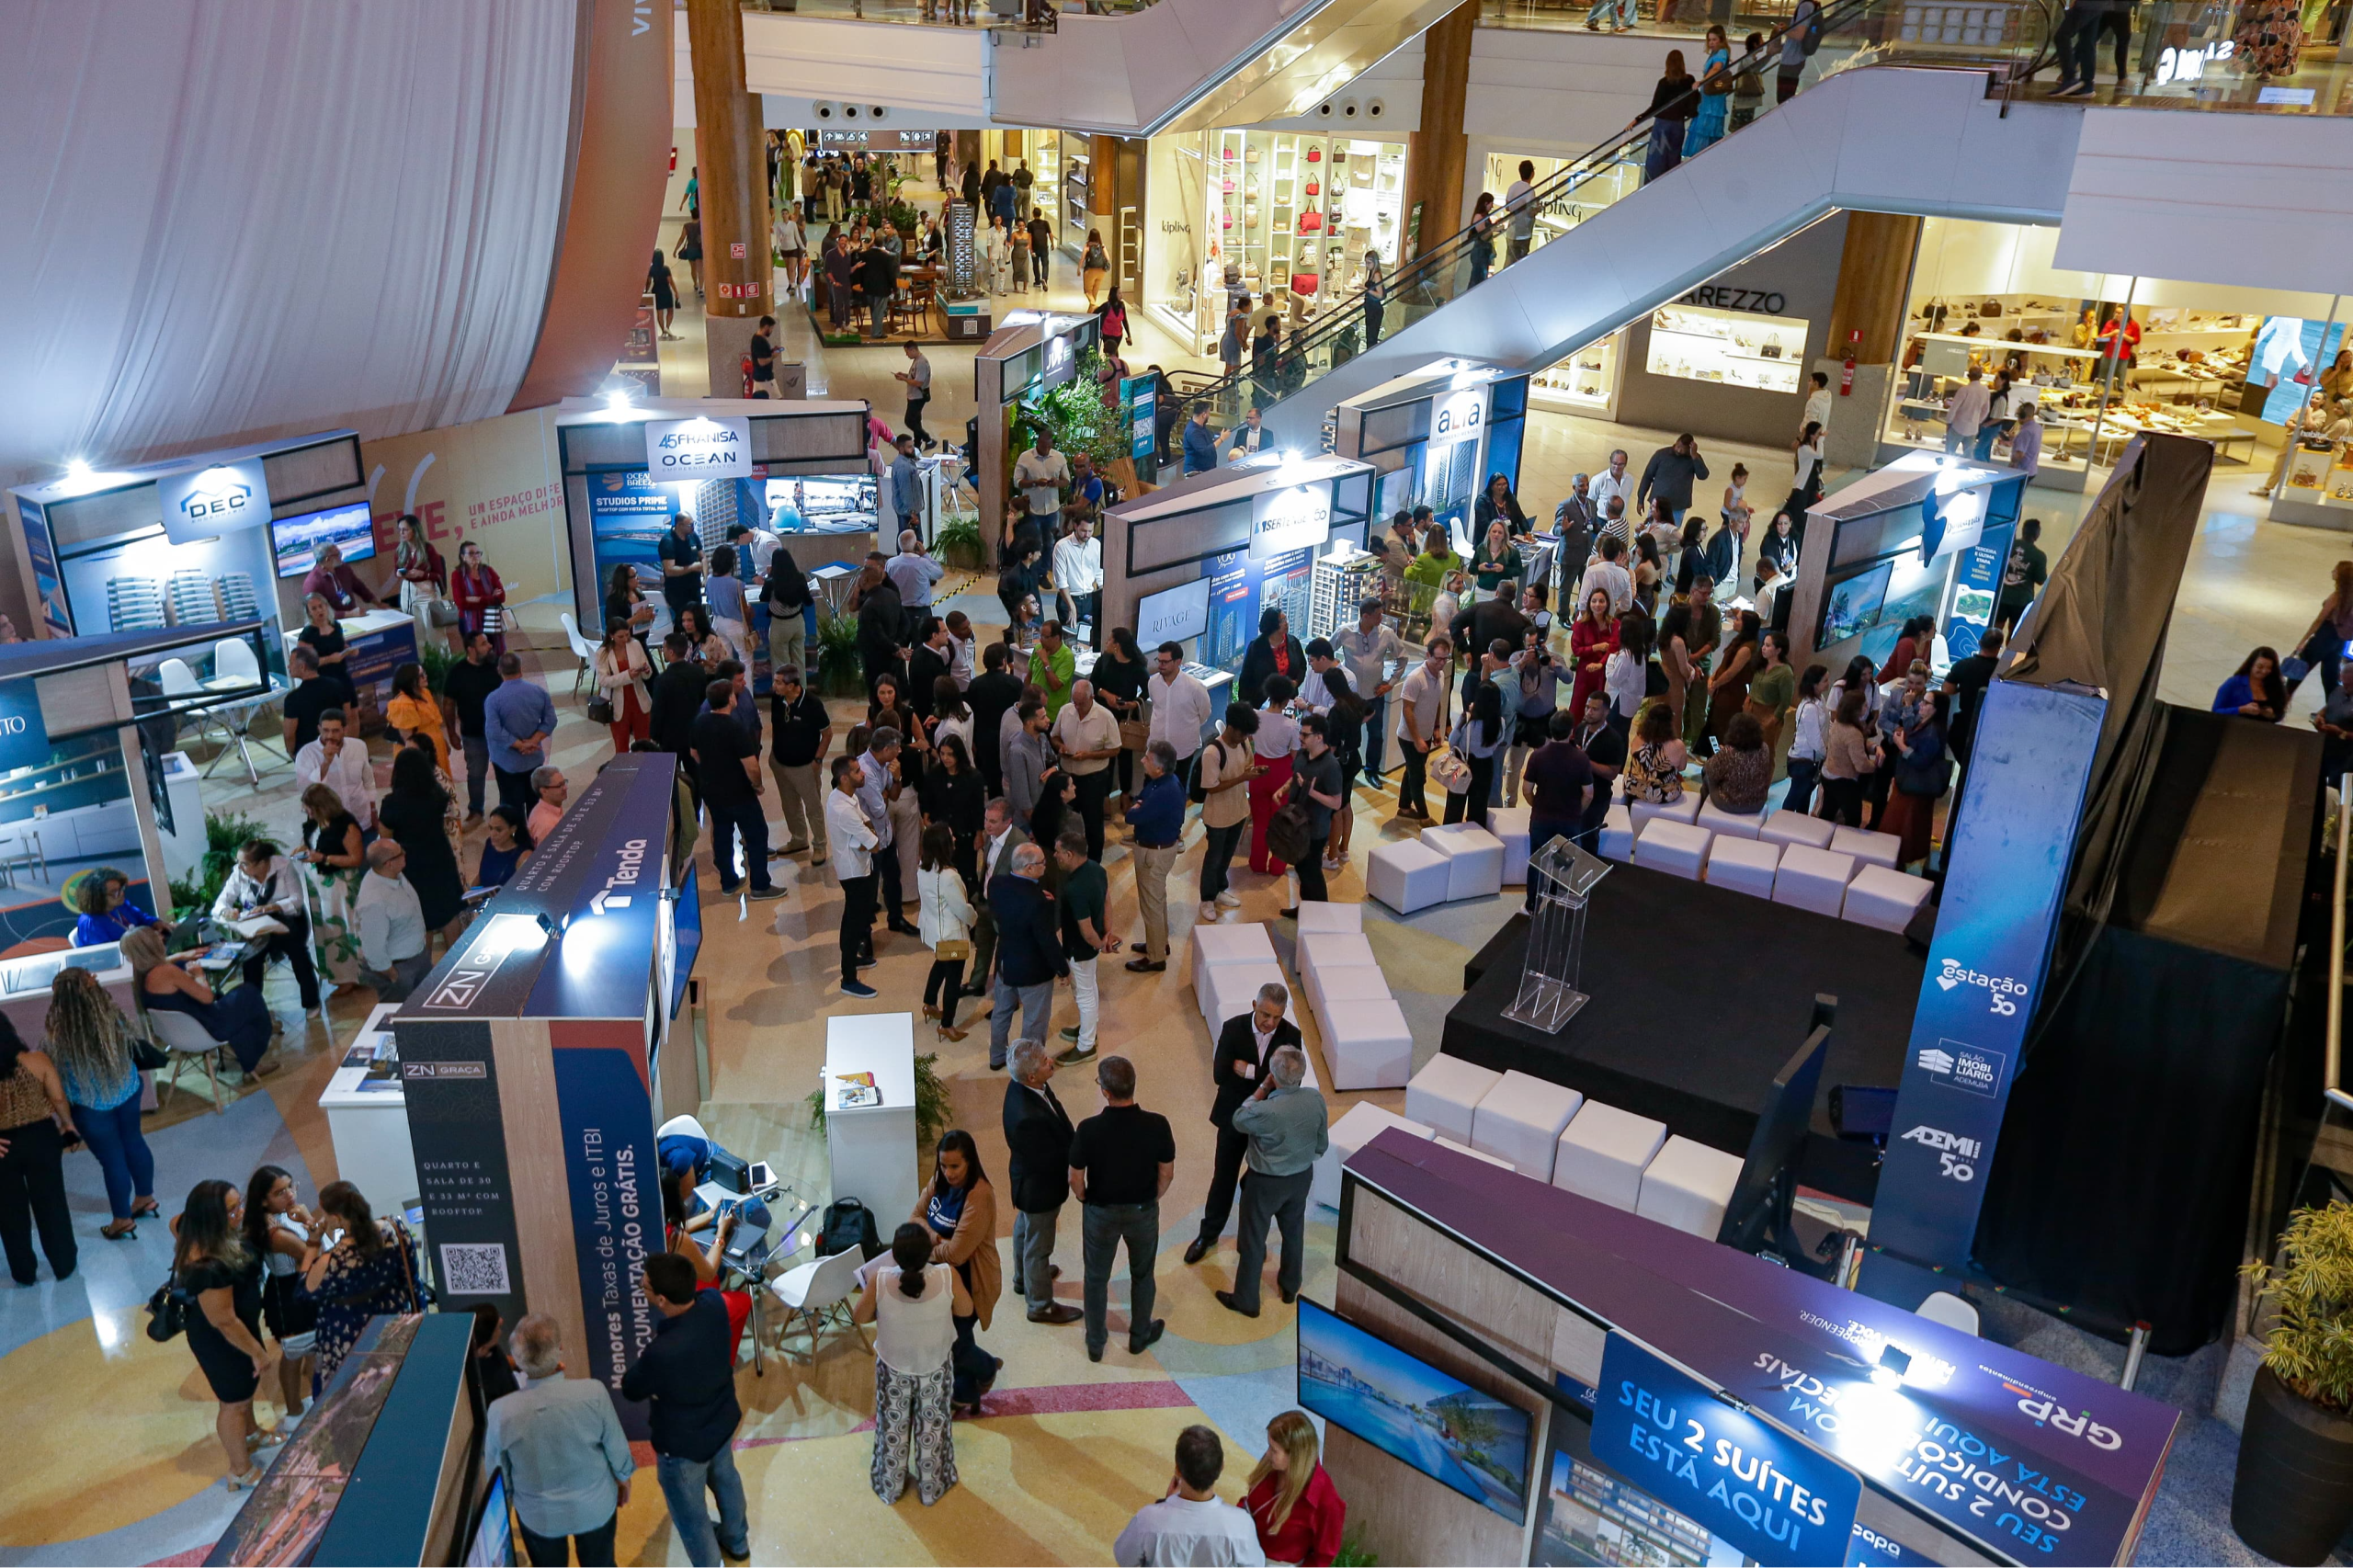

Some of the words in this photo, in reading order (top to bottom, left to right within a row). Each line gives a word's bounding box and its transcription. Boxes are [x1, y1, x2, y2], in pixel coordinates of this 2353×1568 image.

[1162, 220, 1191, 235] kipling
[662, 451, 737, 466] OCEAN
[189, 494, 245, 518] DEC
[470, 518, 478, 529] E
[481, 508, 516, 528] AINDA
[518, 495, 564, 517] MELHOR
[489, 490, 532, 511] ESPAÇO
[596, 496, 637, 506] STUDIOS
[638, 495, 668, 506] PRIME
[1153, 608, 1191, 633] RIVAGE
[516, 860, 547, 892] QUARTO
[550, 834, 568, 853] SALA
[563, 823, 577, 834] DE
[572, 812, 585, 823] 30
[606, 838, 648, 889] Tenda
[537, 875, 557, 892] COM
[435, 971, 485, 1006] ZN
[1942, 965, 2028, 996] estação
[1990, 993, 2017, 1017] 50
[406, 1064, 435, 1076] ZN
[440, 1065, 481, 1074] GRAÇA
[1958, 1057, 1992, 1074] IMOBI
[1960, 1051, 1985, 1062] SALÃO
[1956, 1064, 1994, 1083] LIÁRIO
[584, 1129, 604, 1162] ITBI
[1901, 1125, 1974, 1158] ADEMI
[424, 1162, 469, 1170] QUARTO
[460, 1176, 473, 1185] DE
[479, 1176, 492, 1185] 30
[592, 1166, 606, 1177] e
[614, 1144, 640, 1219] GRÁTIS.
[1939, 1152, 1974, 1182] 50
[440, 1192, 452, 1200] 33
[476, 1192, 500, 1200] COM
[594, 1181, 612, 1232] Juros
[599, 1235, 614, 1258] de
[602, 1262, 619, 1309] Taxas
[608, 1312, 626, 1390] Menores
[1978, 1363, 2058, 1402] empreendimentos
[1788, 1396, 1841, 1433] OM
[2017, 1397, 2122, 1451] GRP
[1619, 1381, 1677, 1431] SEU
[1682, 1418, 1706, 1453] 2
[1712, 1437, 1828, 1527] SUÍTES
[1924, 1416, 2012, 1467] AQUI
[1629, 1423, 1699, 1490] ESTÁ
[1707, 1478, 1802, 1551] AQUI
[1891, 1456, 1966, 1501] SUÍT
[1901, 1431, 2072, 1532] CONDIÇÕE
[2013, 1461, 2087, 1513] ESTÁ
[1969, 1494, 1995, 1517] 2
[1995, 1511, 2061, 1553] SEU
